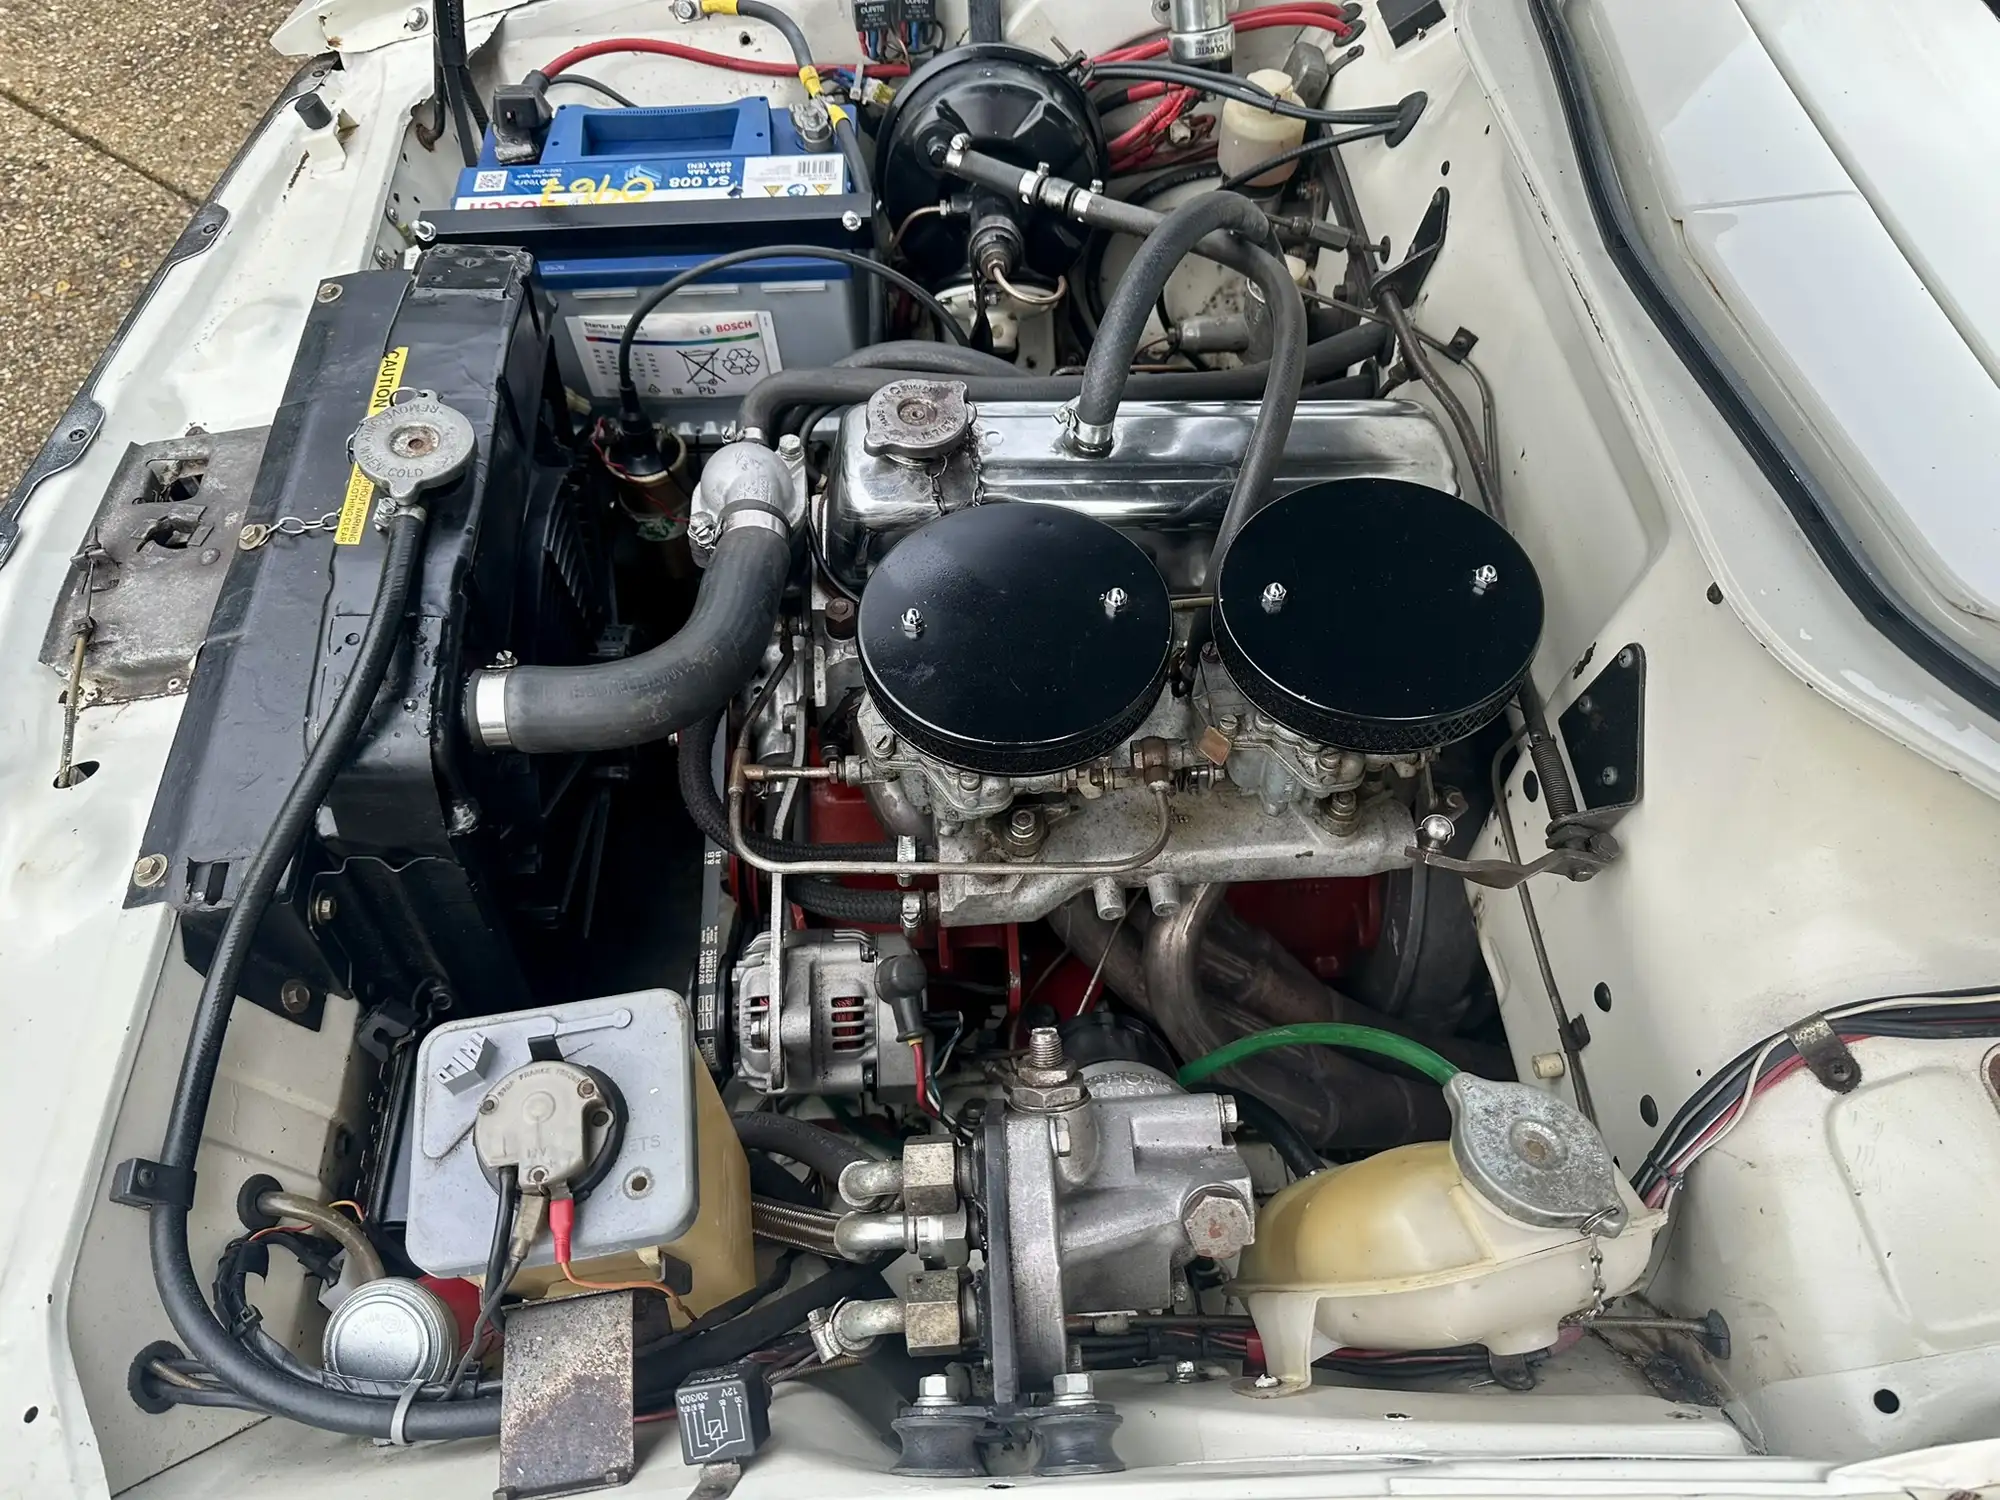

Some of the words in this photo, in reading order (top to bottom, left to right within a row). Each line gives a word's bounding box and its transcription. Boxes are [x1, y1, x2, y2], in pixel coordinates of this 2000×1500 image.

[513, 179, 540, 187] Years
[669, 176, 702, 188] 008
[707, 175, 730, 186] S4
[584, 321, 609, 329] Starter
[715, 320, 752, 333] BOSCH
[373, 350, 400, 409] CAUTION
[698, 386, 716, 396] Pb
[384, 403, 439, 421] REMOVE
[360, 446, 384, 472] WHEN
[387, 466, 424, 479] COLD
[346, 481, 362, 518] CLOTHING
[340, 518, 352, 544] CLEAR
[705, 949, 714, 985] 6275MC
[678, 1391, 709, 1405] 20/30A
[721, 1387, 739, 1398] 12V
